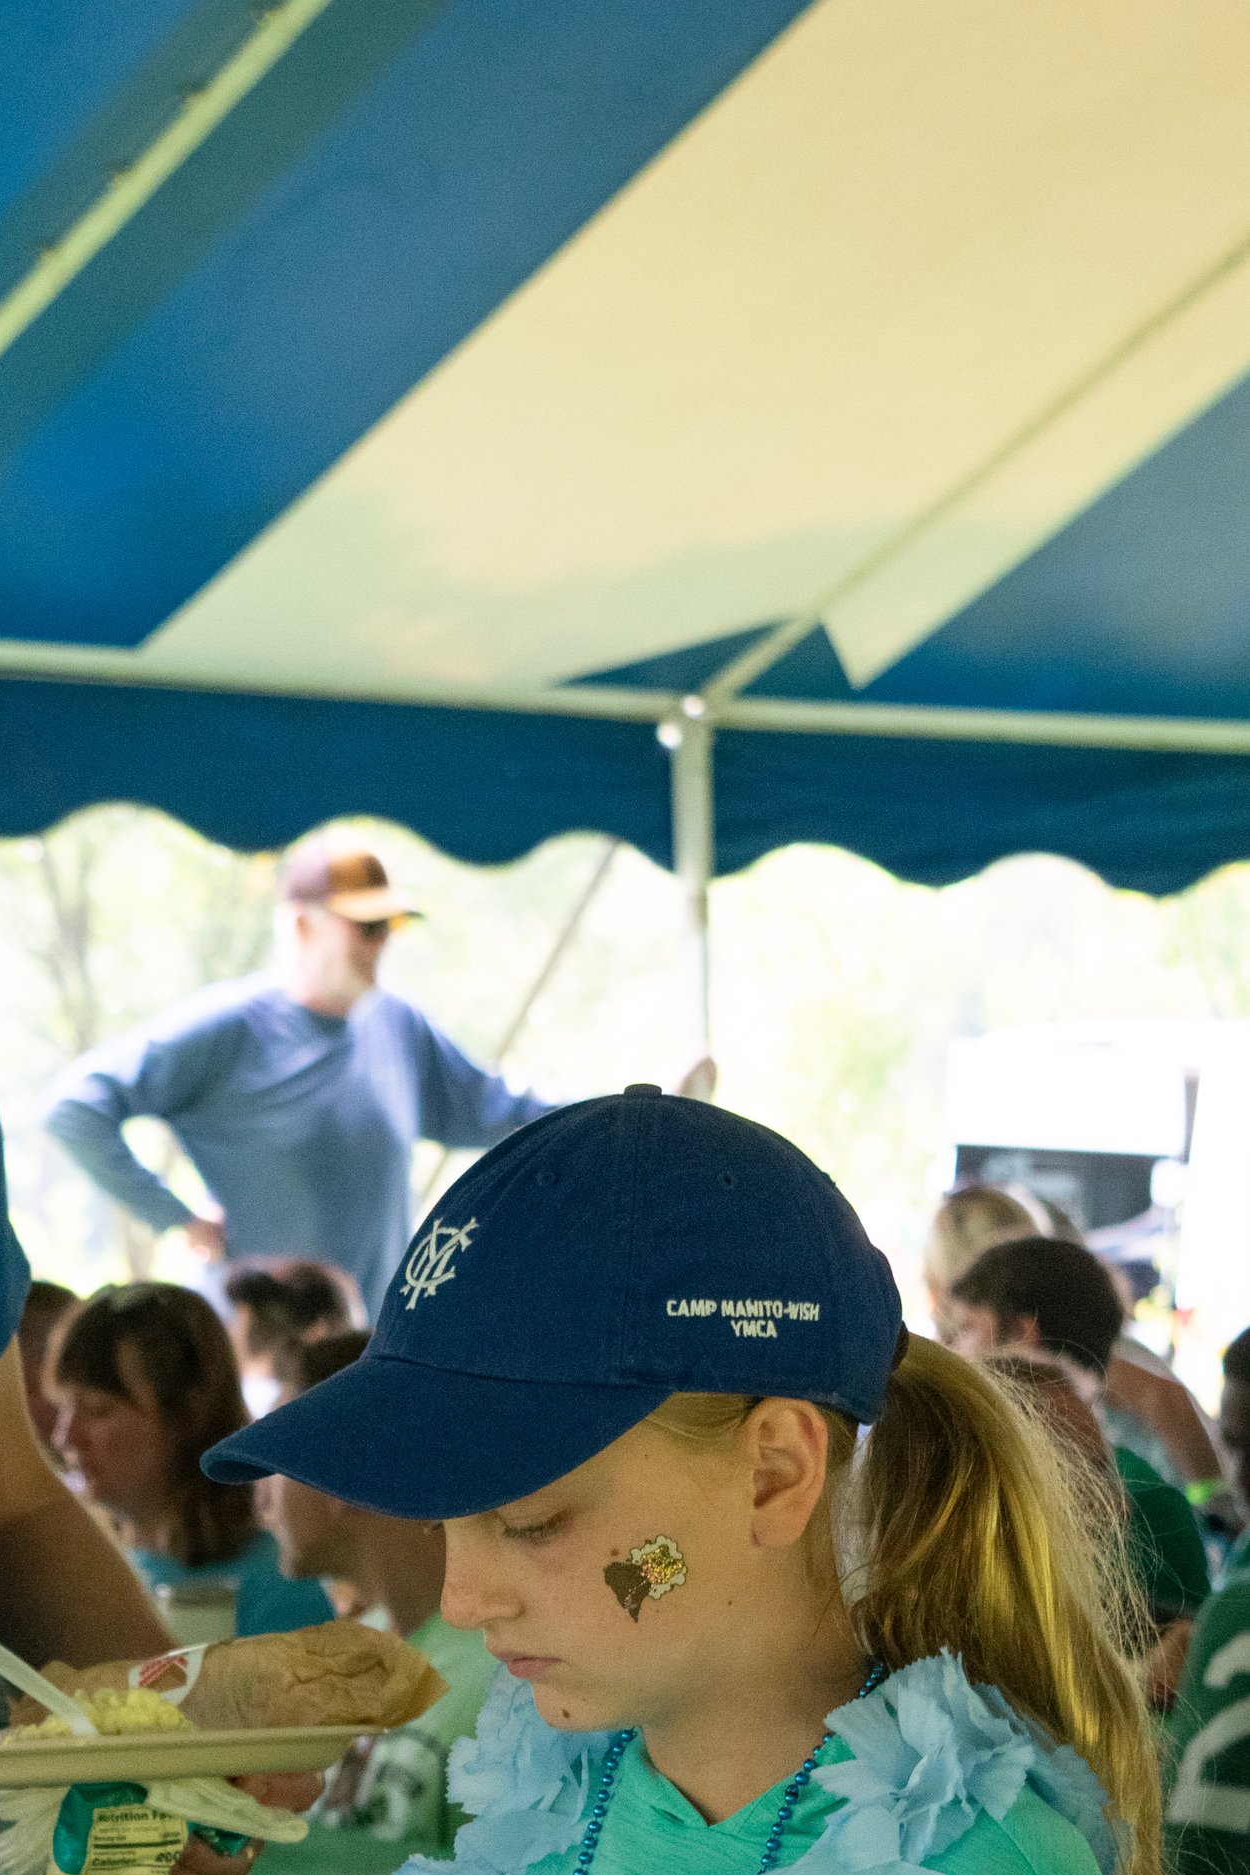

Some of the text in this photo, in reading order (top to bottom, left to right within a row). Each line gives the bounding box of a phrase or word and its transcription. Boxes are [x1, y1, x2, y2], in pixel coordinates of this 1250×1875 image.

[666, 1299, 821, 1322] CAMP MANITO-WISH
[730, 1319, 779, 1339] YMCA
